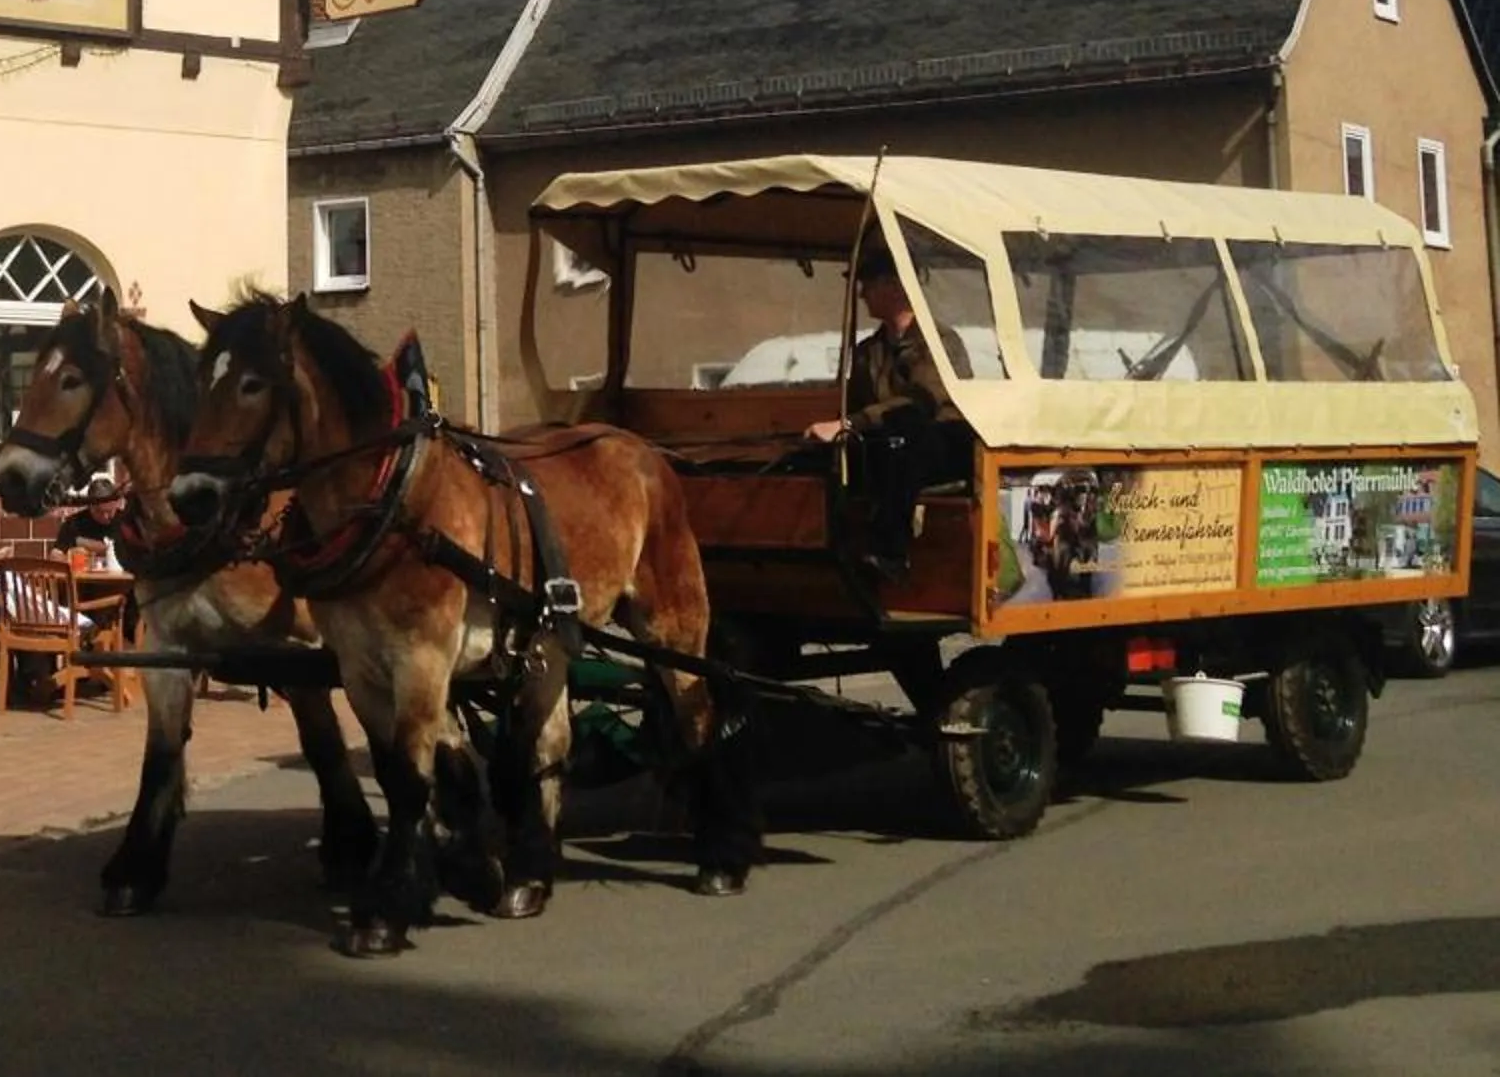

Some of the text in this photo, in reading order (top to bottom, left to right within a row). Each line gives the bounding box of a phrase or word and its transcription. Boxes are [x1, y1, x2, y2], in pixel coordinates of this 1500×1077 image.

[1170, 480, 1203, 507] und
[1263, 466, 1419, 499] Waldhotel Pfarrmühle
